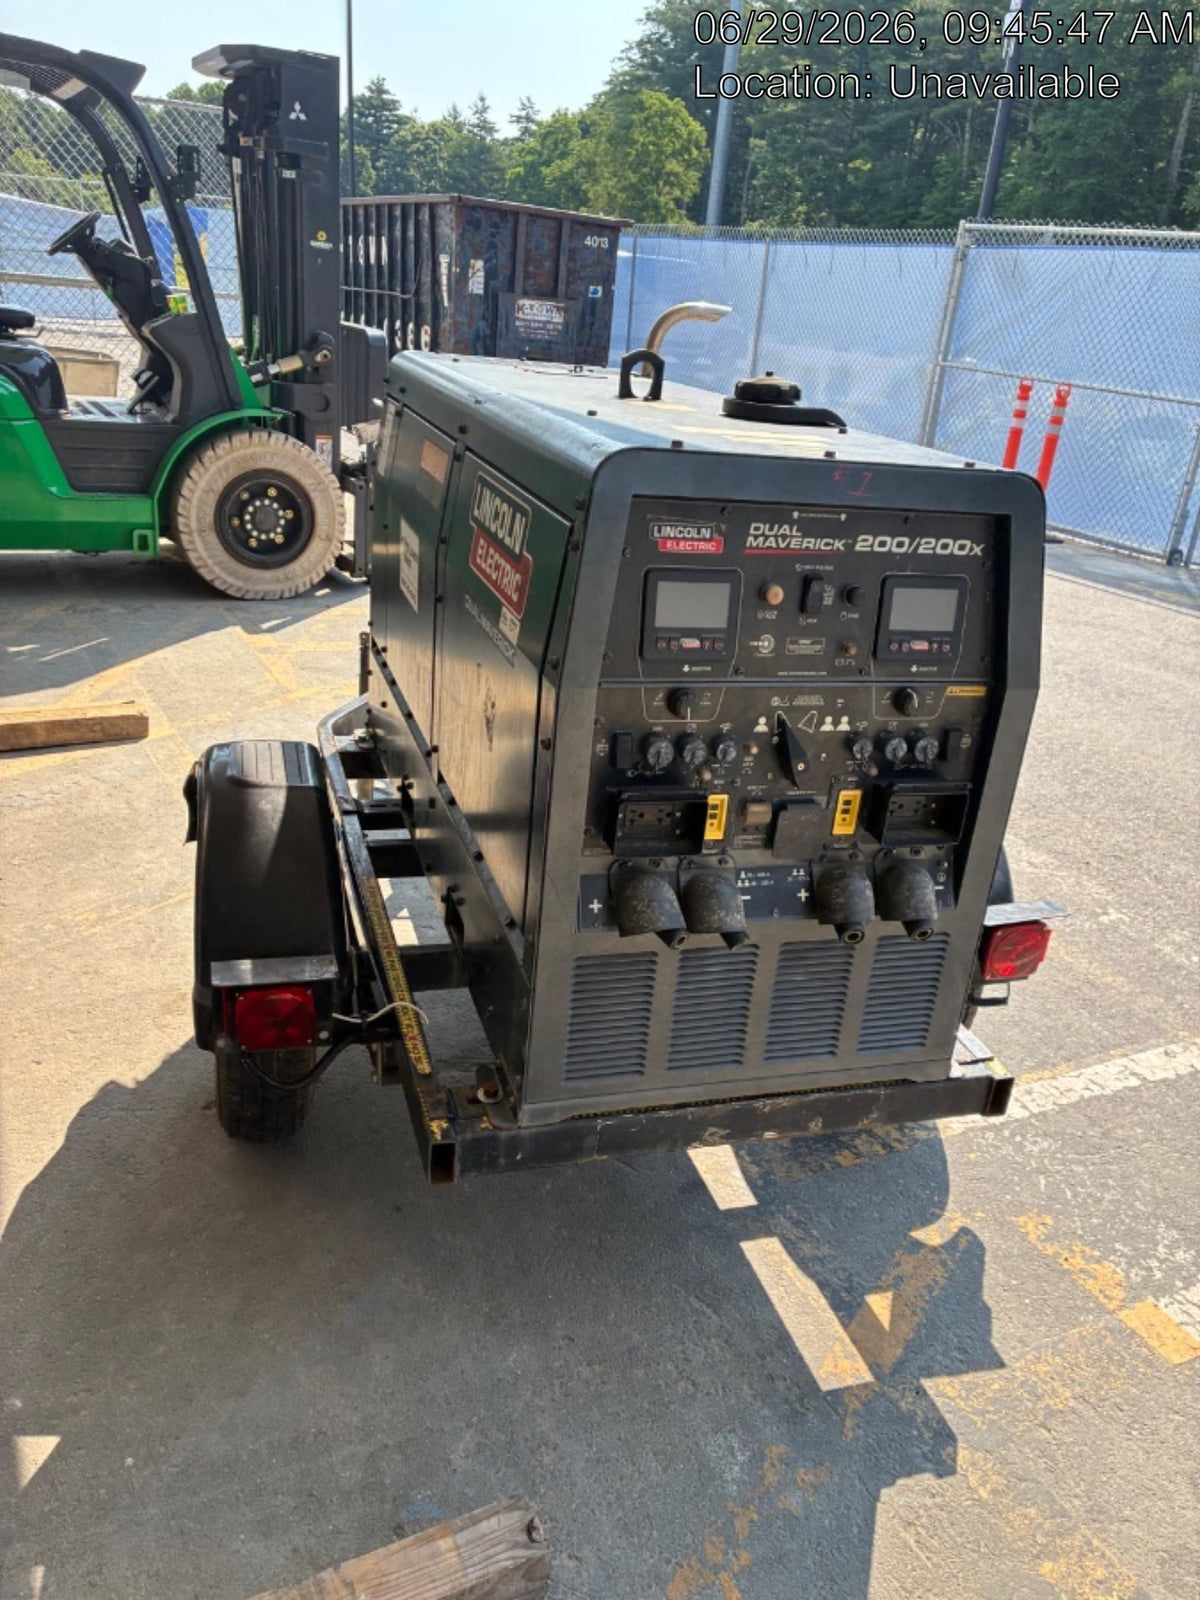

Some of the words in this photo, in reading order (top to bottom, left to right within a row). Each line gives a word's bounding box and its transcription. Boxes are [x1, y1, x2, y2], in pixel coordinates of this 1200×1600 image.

[584, 235, 609, 249] 4013
[473, 482, 526, 556] LINCOLN
[652, 525, 712, 539] LINCOLN
[749, 522, 803, 536] DUAL
[665, 540, 717, 551] ELECTRIC
[745, 535, 847, 551] MAVERICK
[475, 536, 522, 603] ELECTRIC
